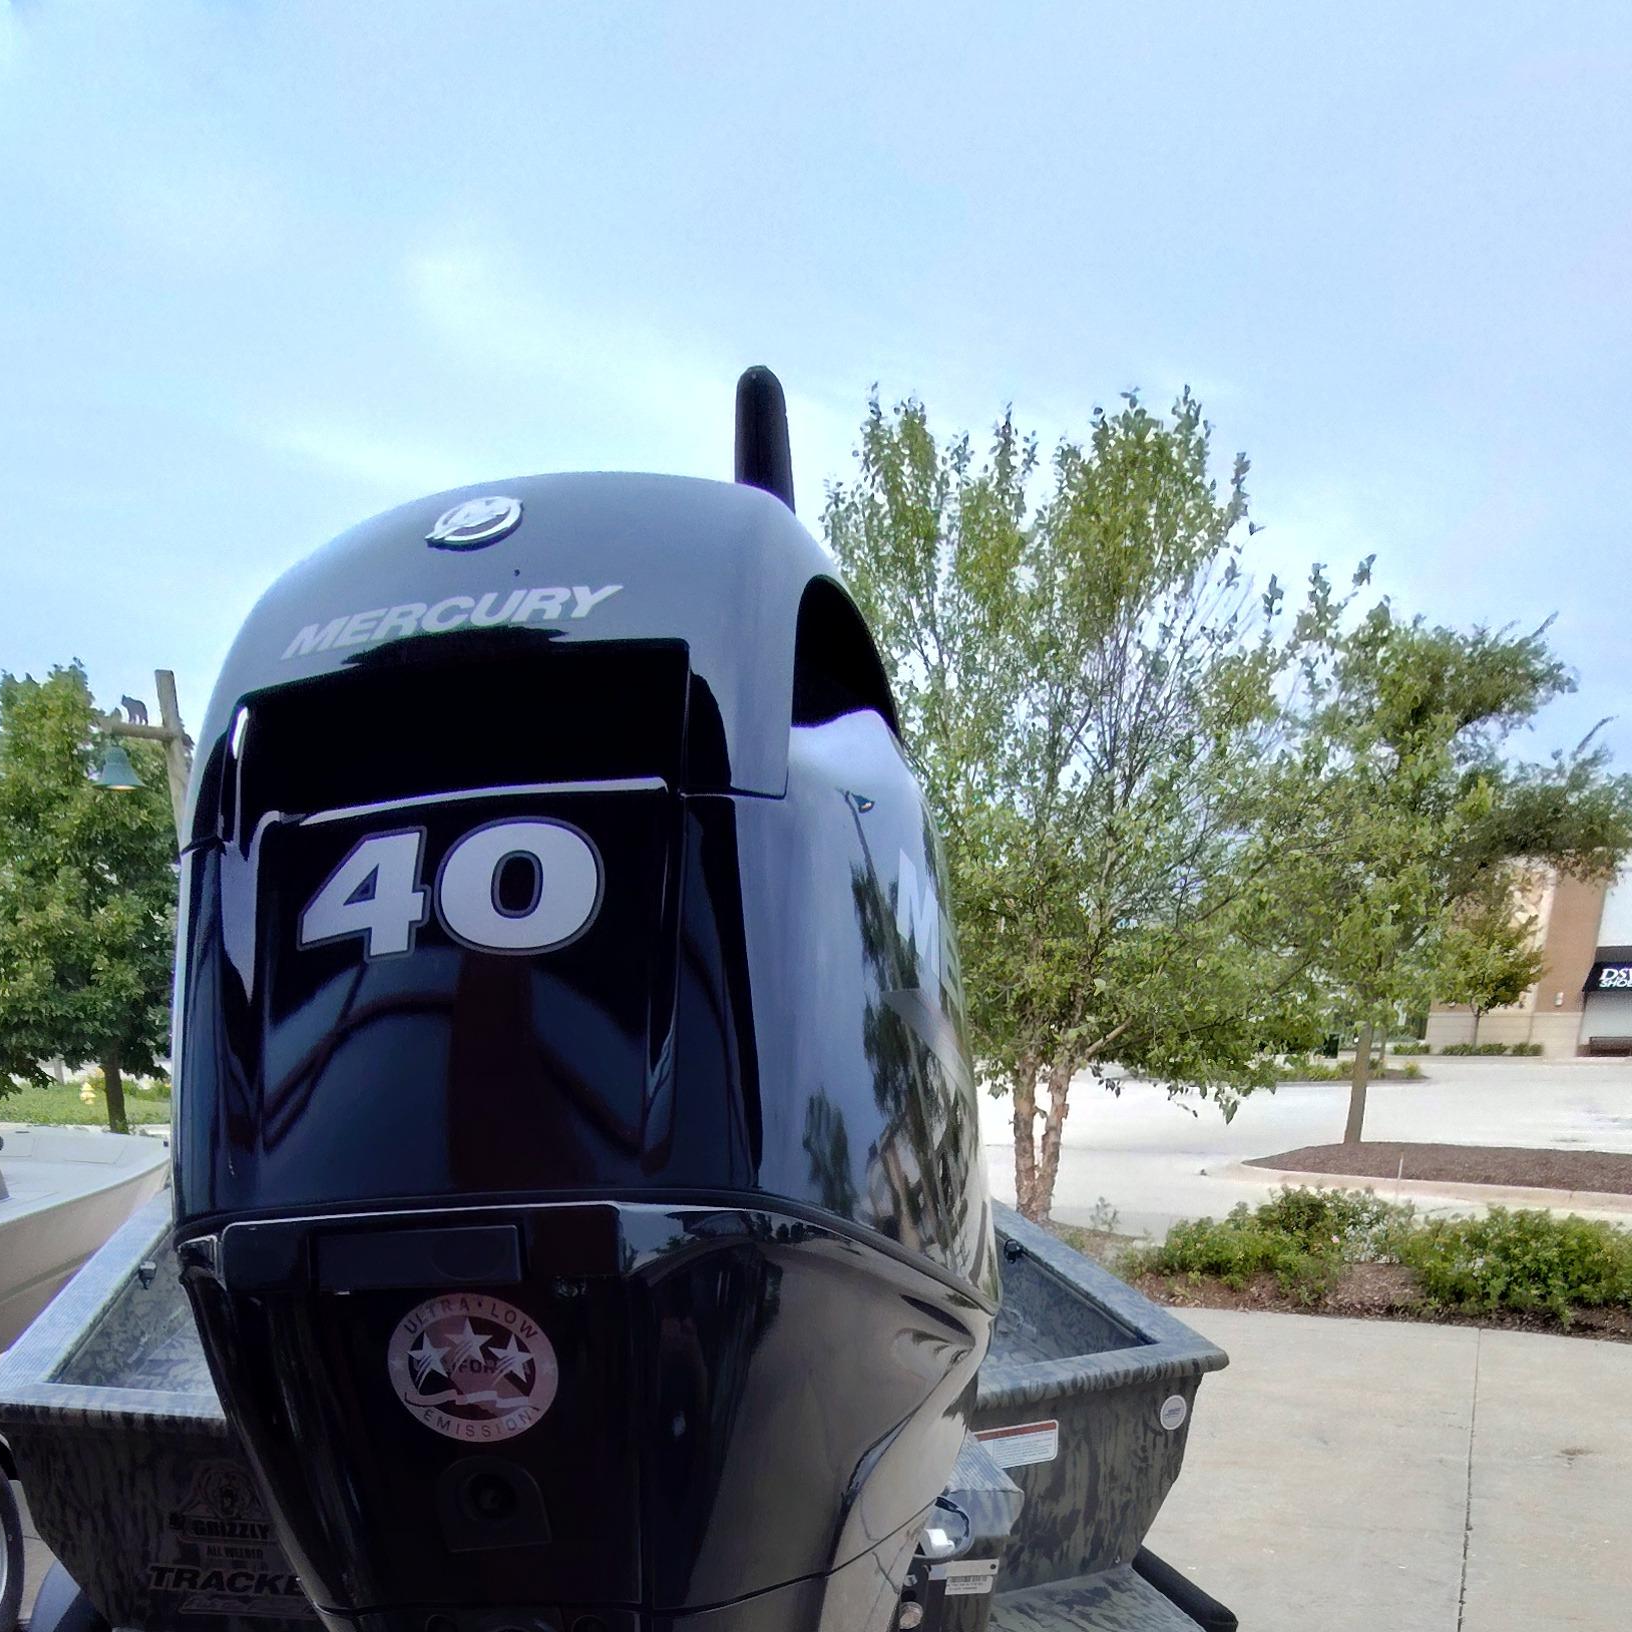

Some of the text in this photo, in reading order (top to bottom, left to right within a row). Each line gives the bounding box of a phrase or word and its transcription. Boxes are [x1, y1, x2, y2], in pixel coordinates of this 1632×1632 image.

[282, 585, 624, 660] MERCURY
[298, 817, 606, 959] 40
[404, 1297, 538, 1339] ULTRA LOW
[423, 1405, 531, 1438] EMISSION
[191, 1520, 270, 1540] GRIZZLY
[149, 1565, 305, 1596] TRACKE
